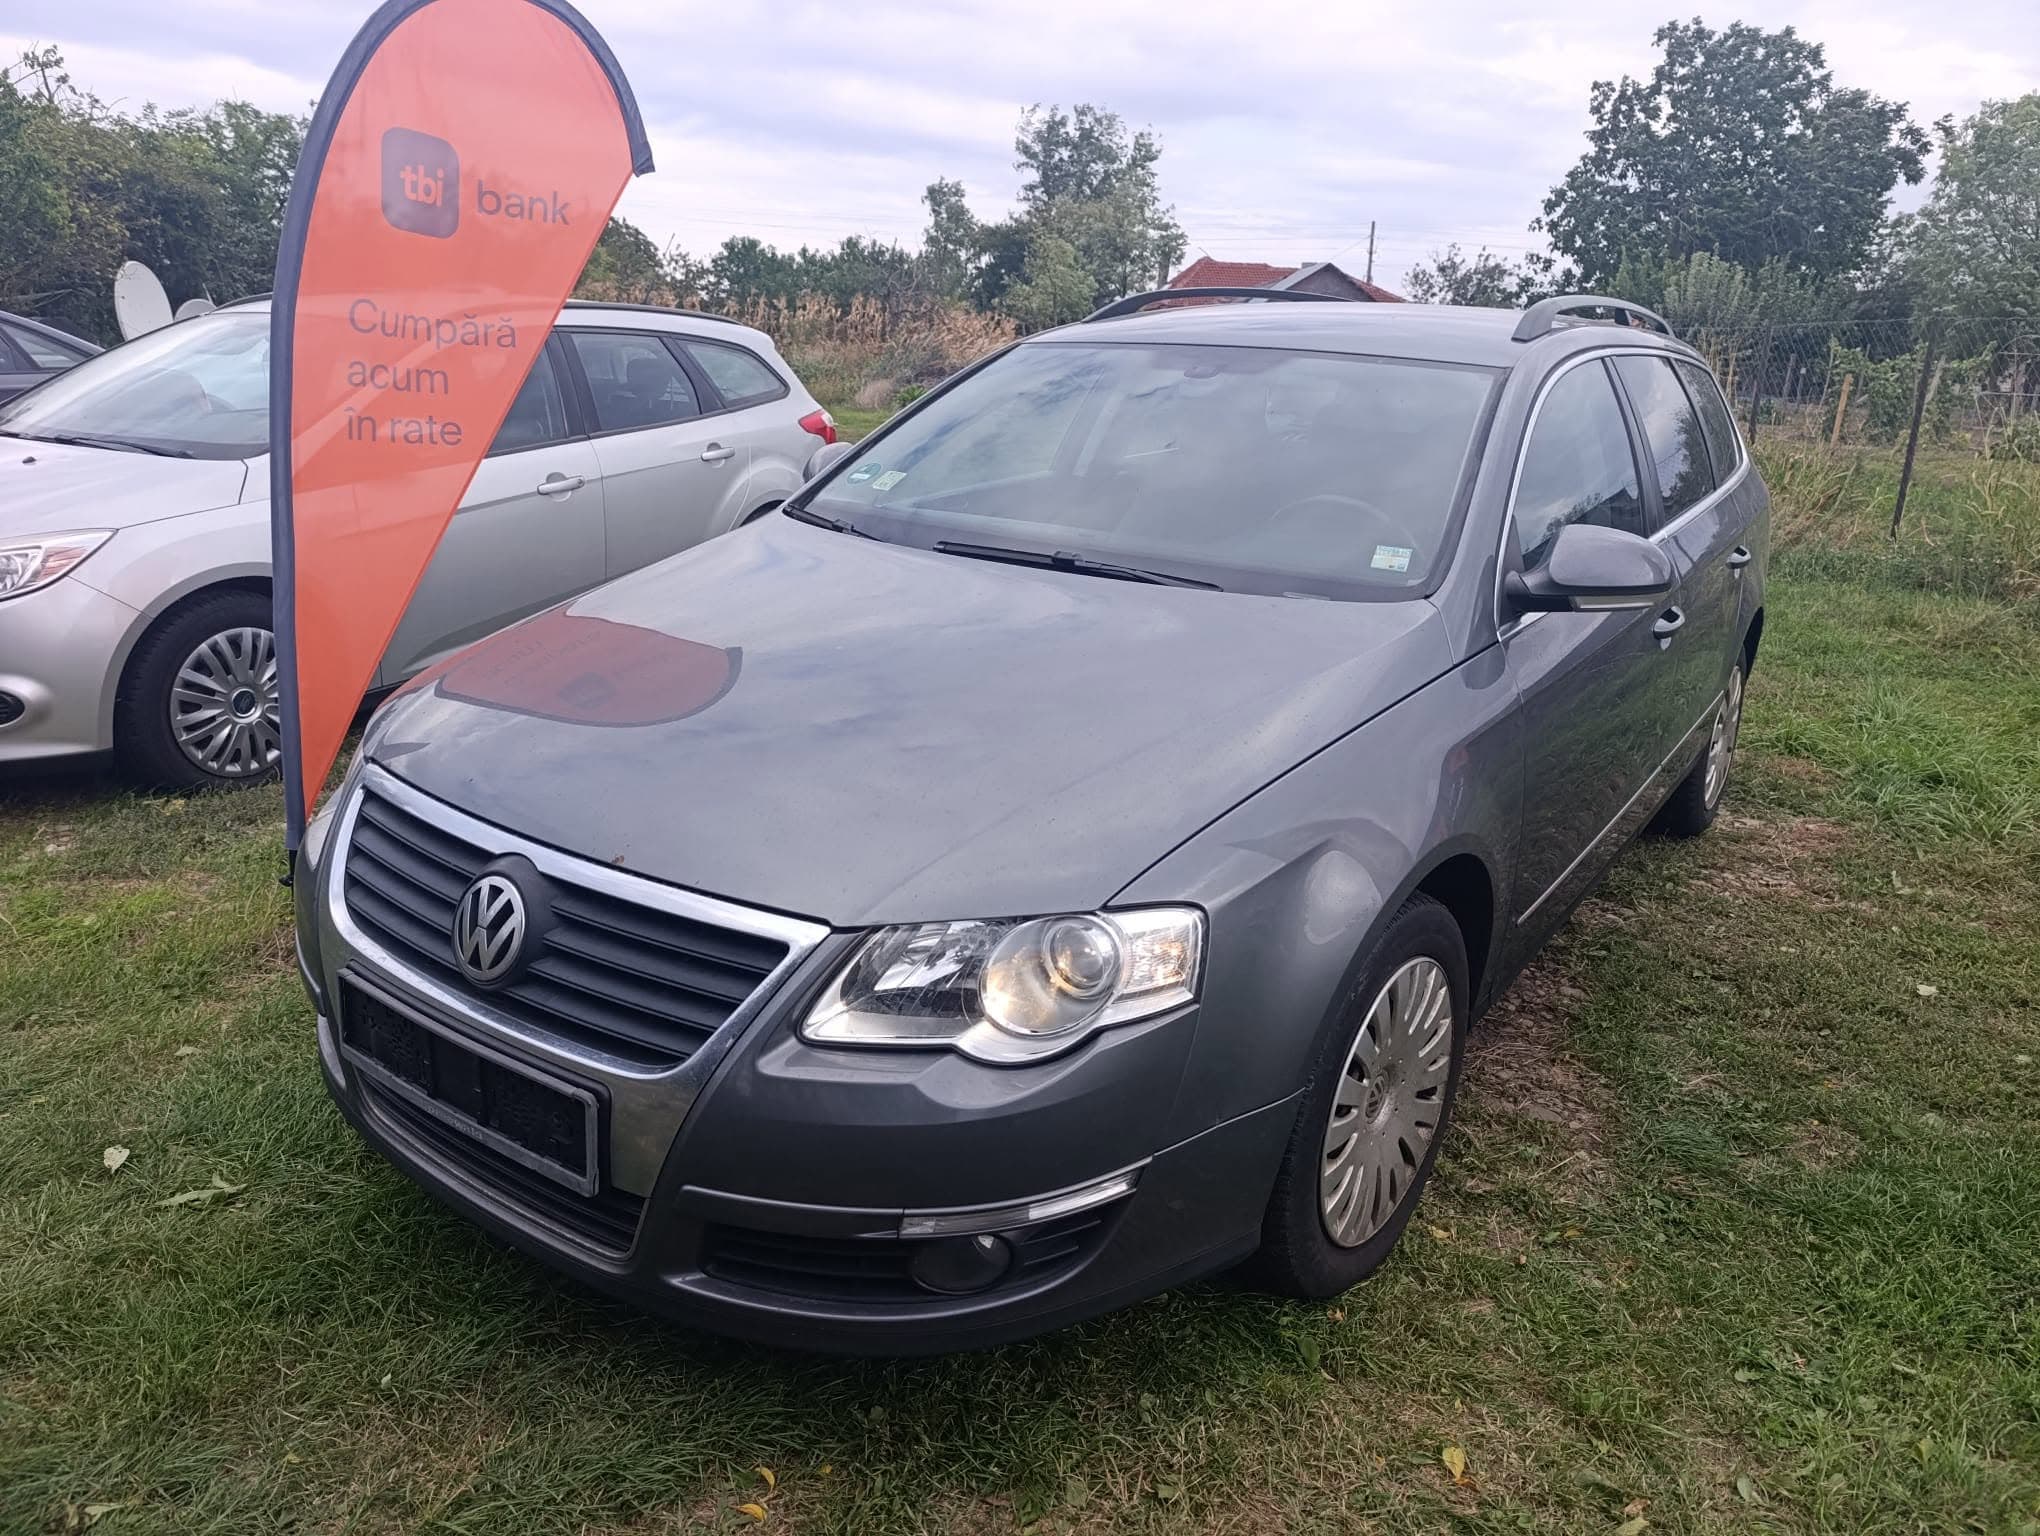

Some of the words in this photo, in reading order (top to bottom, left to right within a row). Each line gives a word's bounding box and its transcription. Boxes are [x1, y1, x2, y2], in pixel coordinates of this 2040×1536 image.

[400, 164, 444, 208] tbi
[477, 179, 571, 226] bank
[348, 298, 517, 350] Cumpără
[347, 360, 449, 395] acum
[344, 406, 377, 442] în
[390, 415, 463, 446] rate
